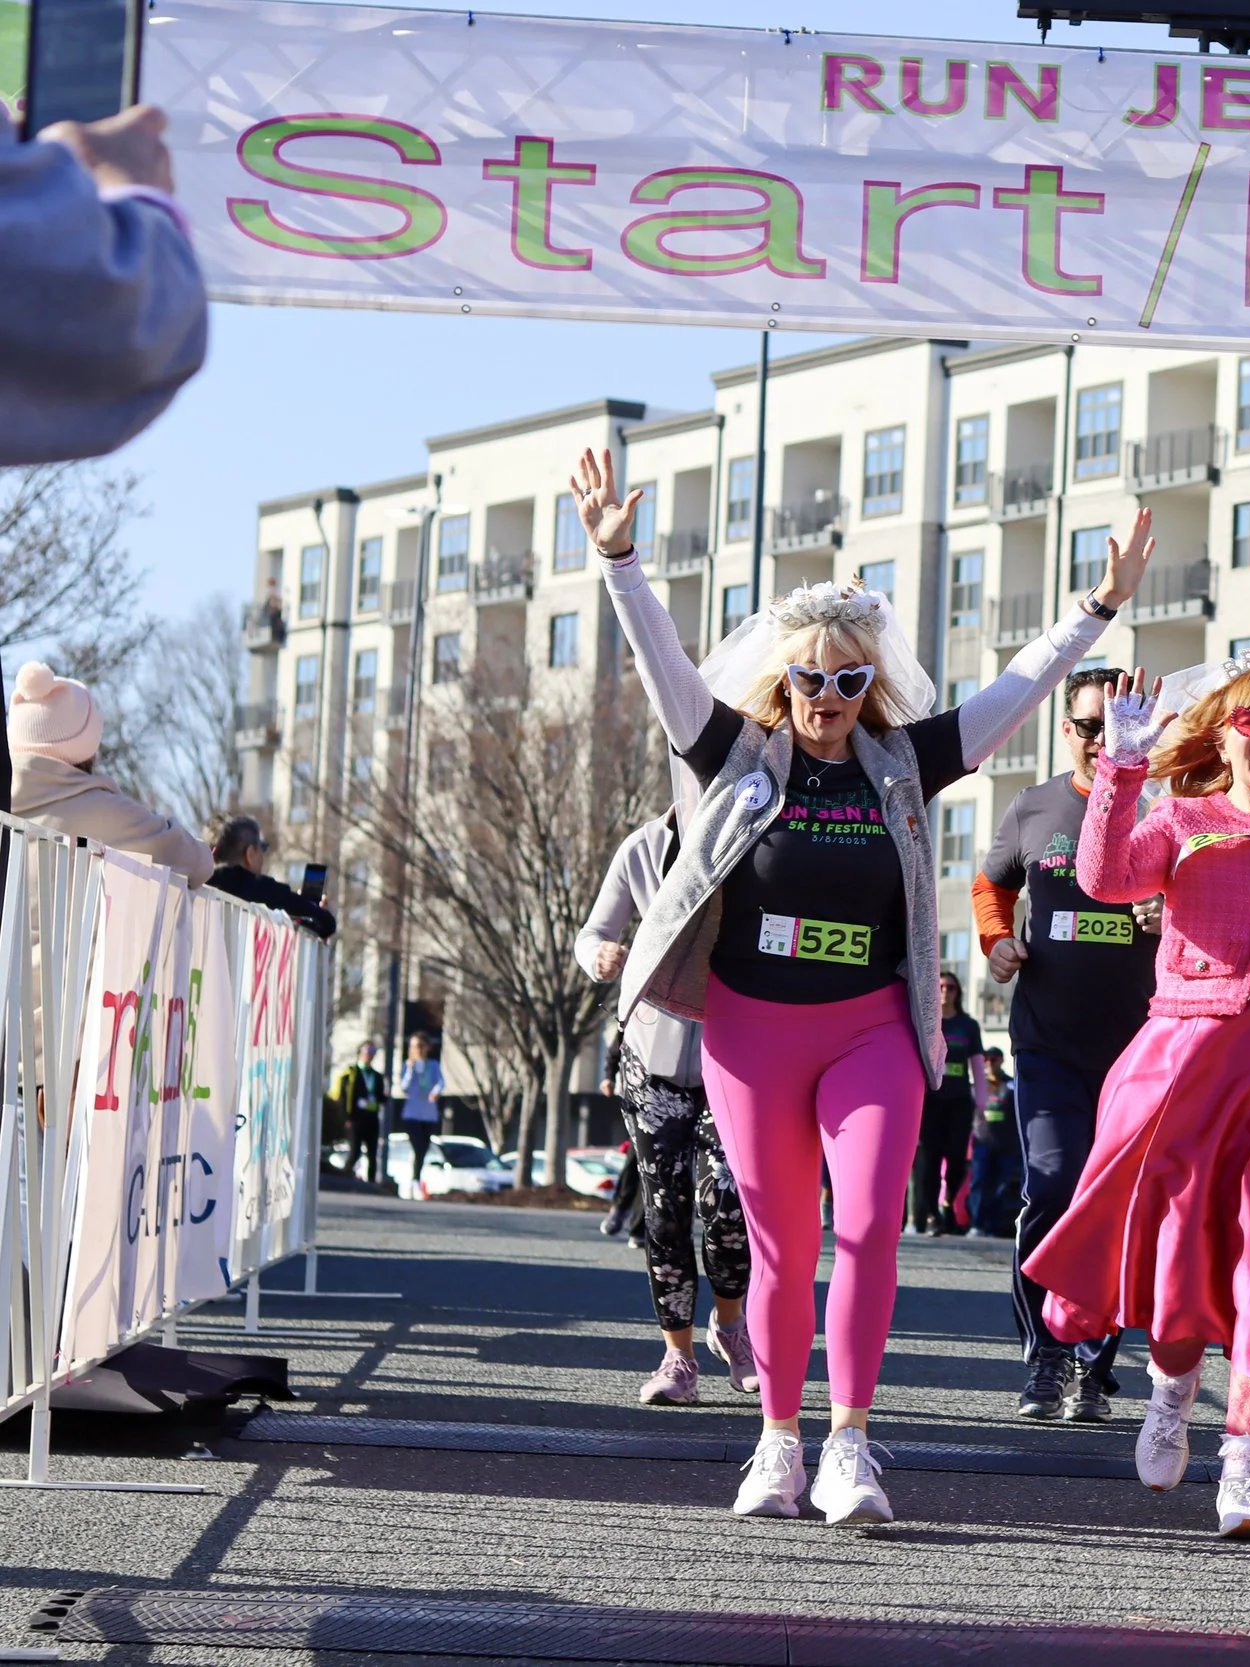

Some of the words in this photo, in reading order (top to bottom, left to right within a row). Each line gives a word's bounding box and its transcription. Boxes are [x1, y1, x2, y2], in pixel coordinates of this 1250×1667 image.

[823, 52, 1061, 122] RUN
[777, 803, 808, 820] UN
[815, 806, 863, 821] JEN
[788, 820, 807, 831] 5K
[811, 822, 820, 832] &
[826, 823, 886, 835] FESTIVAL
[811, 834, 867, 845] 3/8/2025
[1039, 854, 1067, 871] RUN
[1053, 868, 1067, 877] 5K
[1078, 919, 1131, 937] 2025
[800, 925, 868, 959] 525
